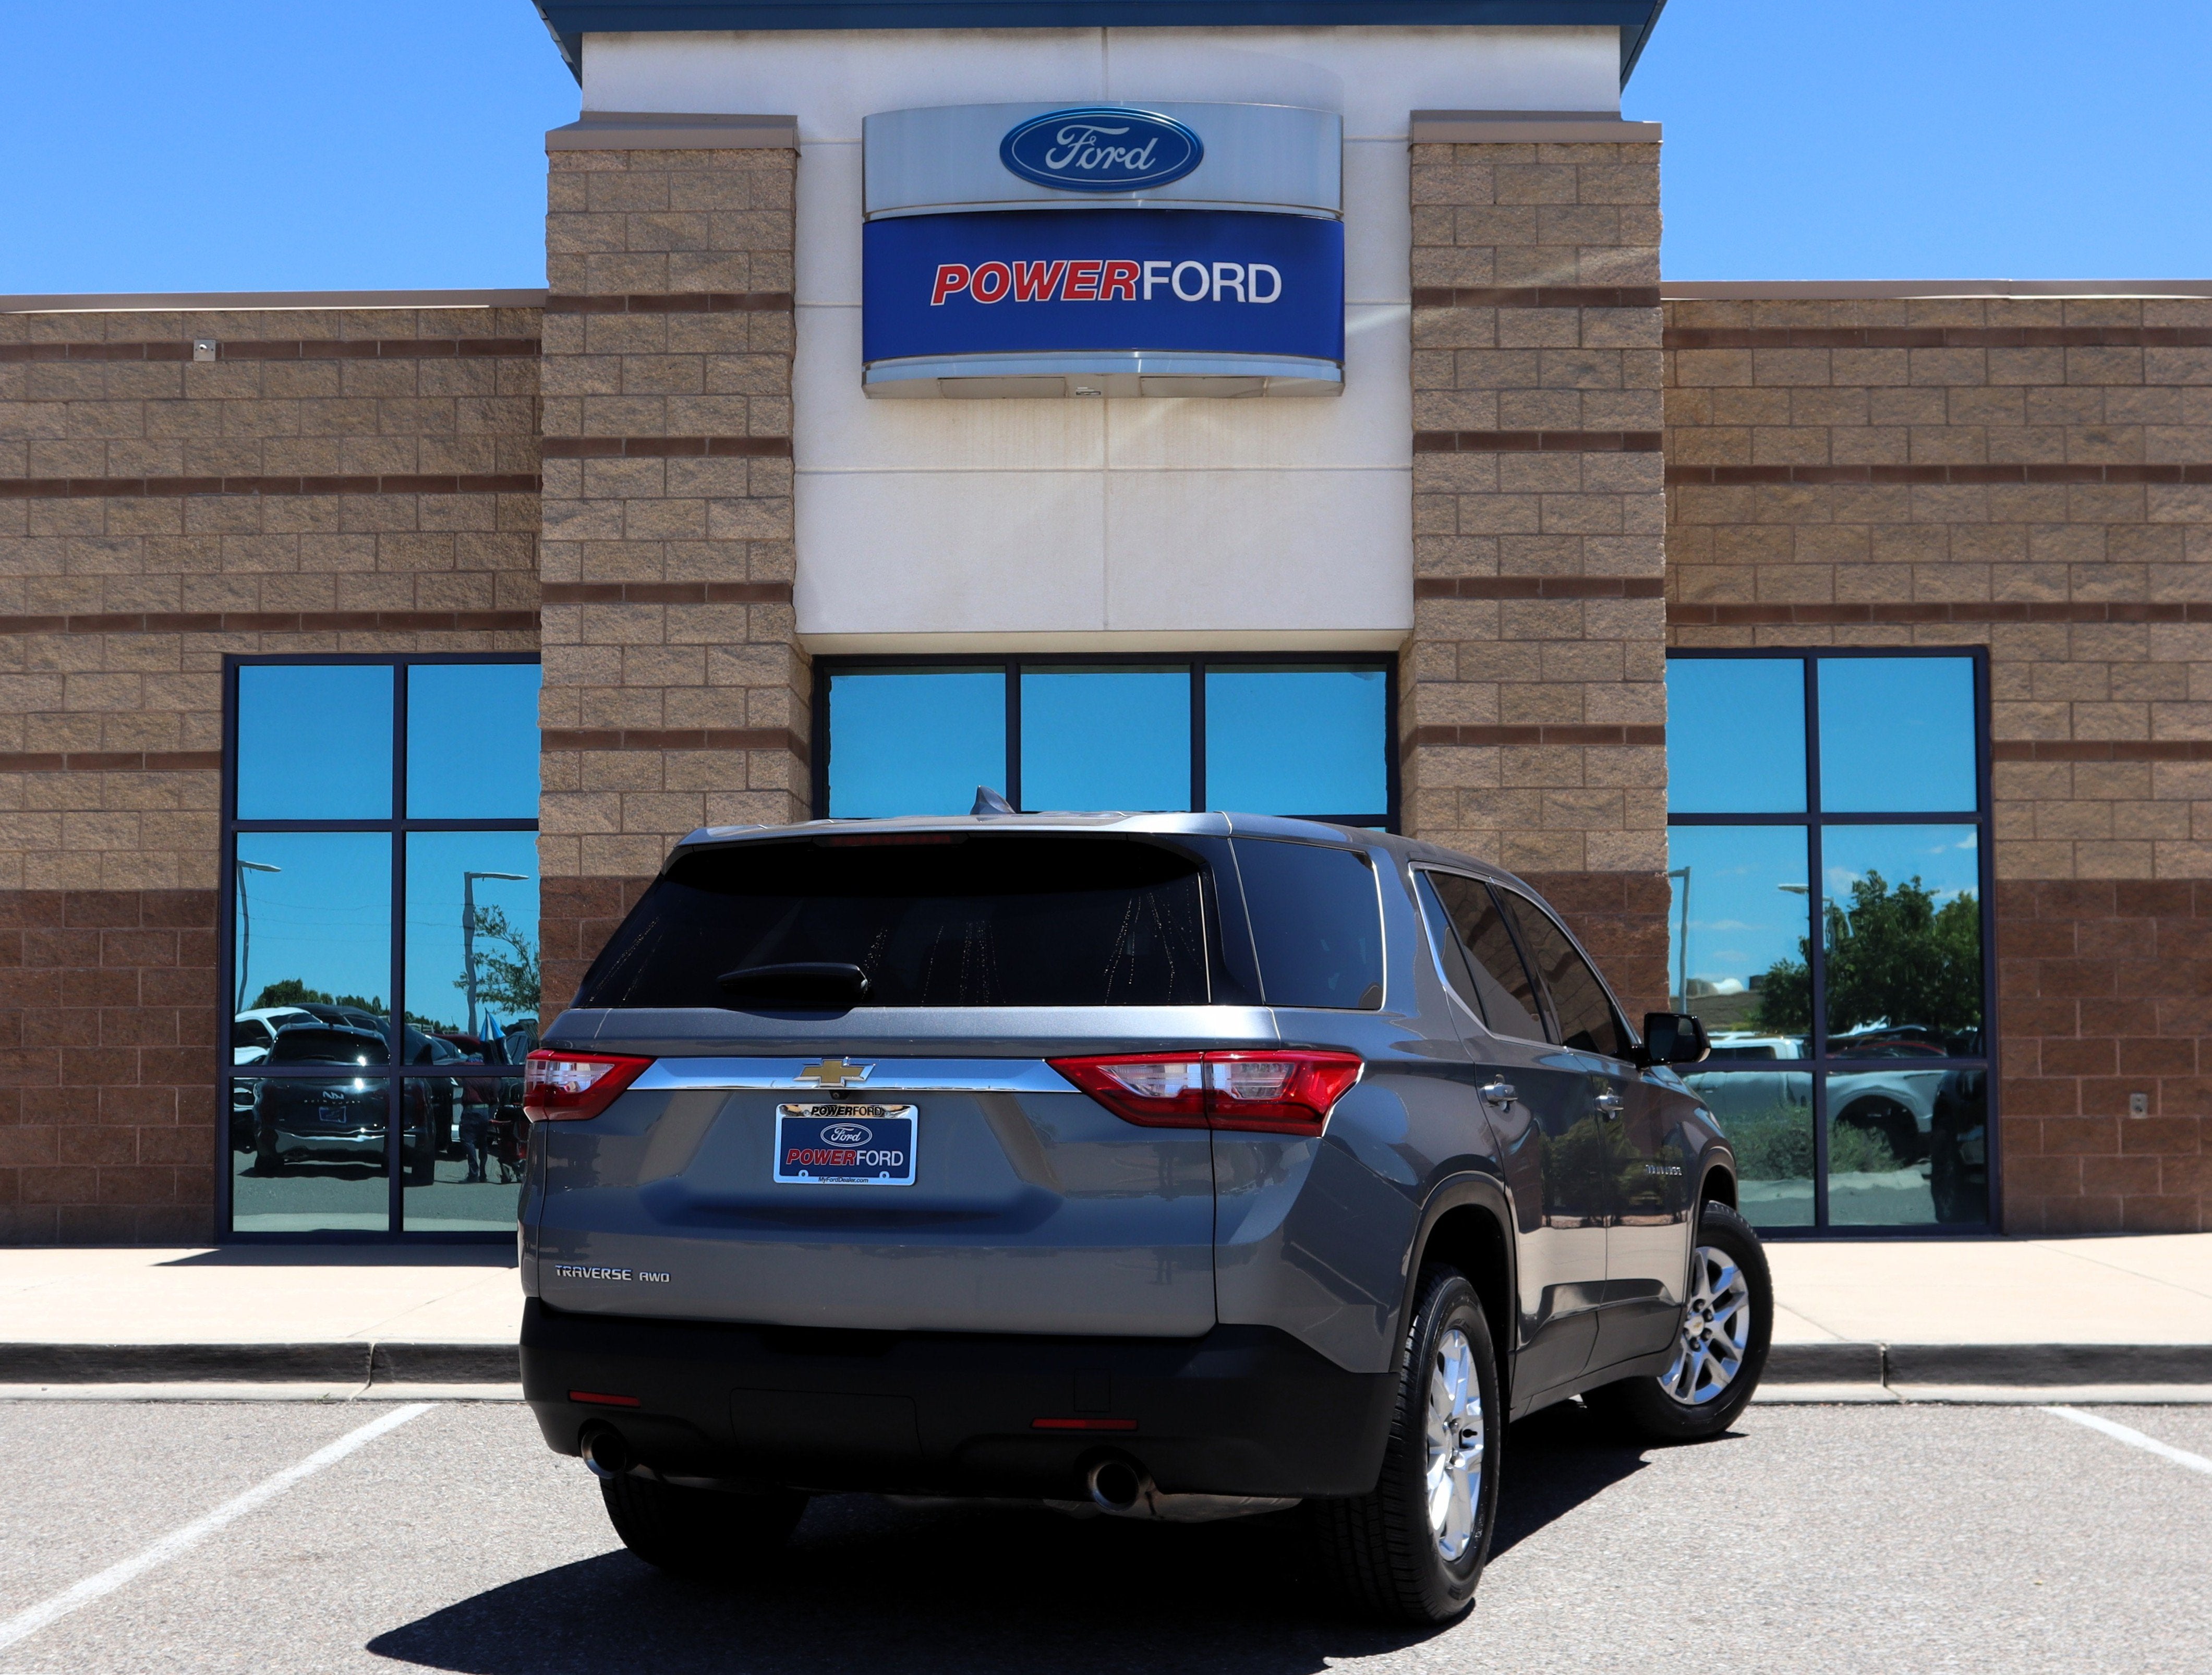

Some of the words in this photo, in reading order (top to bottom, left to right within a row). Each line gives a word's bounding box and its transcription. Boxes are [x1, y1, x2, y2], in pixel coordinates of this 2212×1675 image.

[1045, 123, 1158, 171] Ford
[831, 1127, 862, 1142] Ford
[555, 1264, 632, 1281] TRAVERSE
[639, 1271, 670, 1283] AWD
